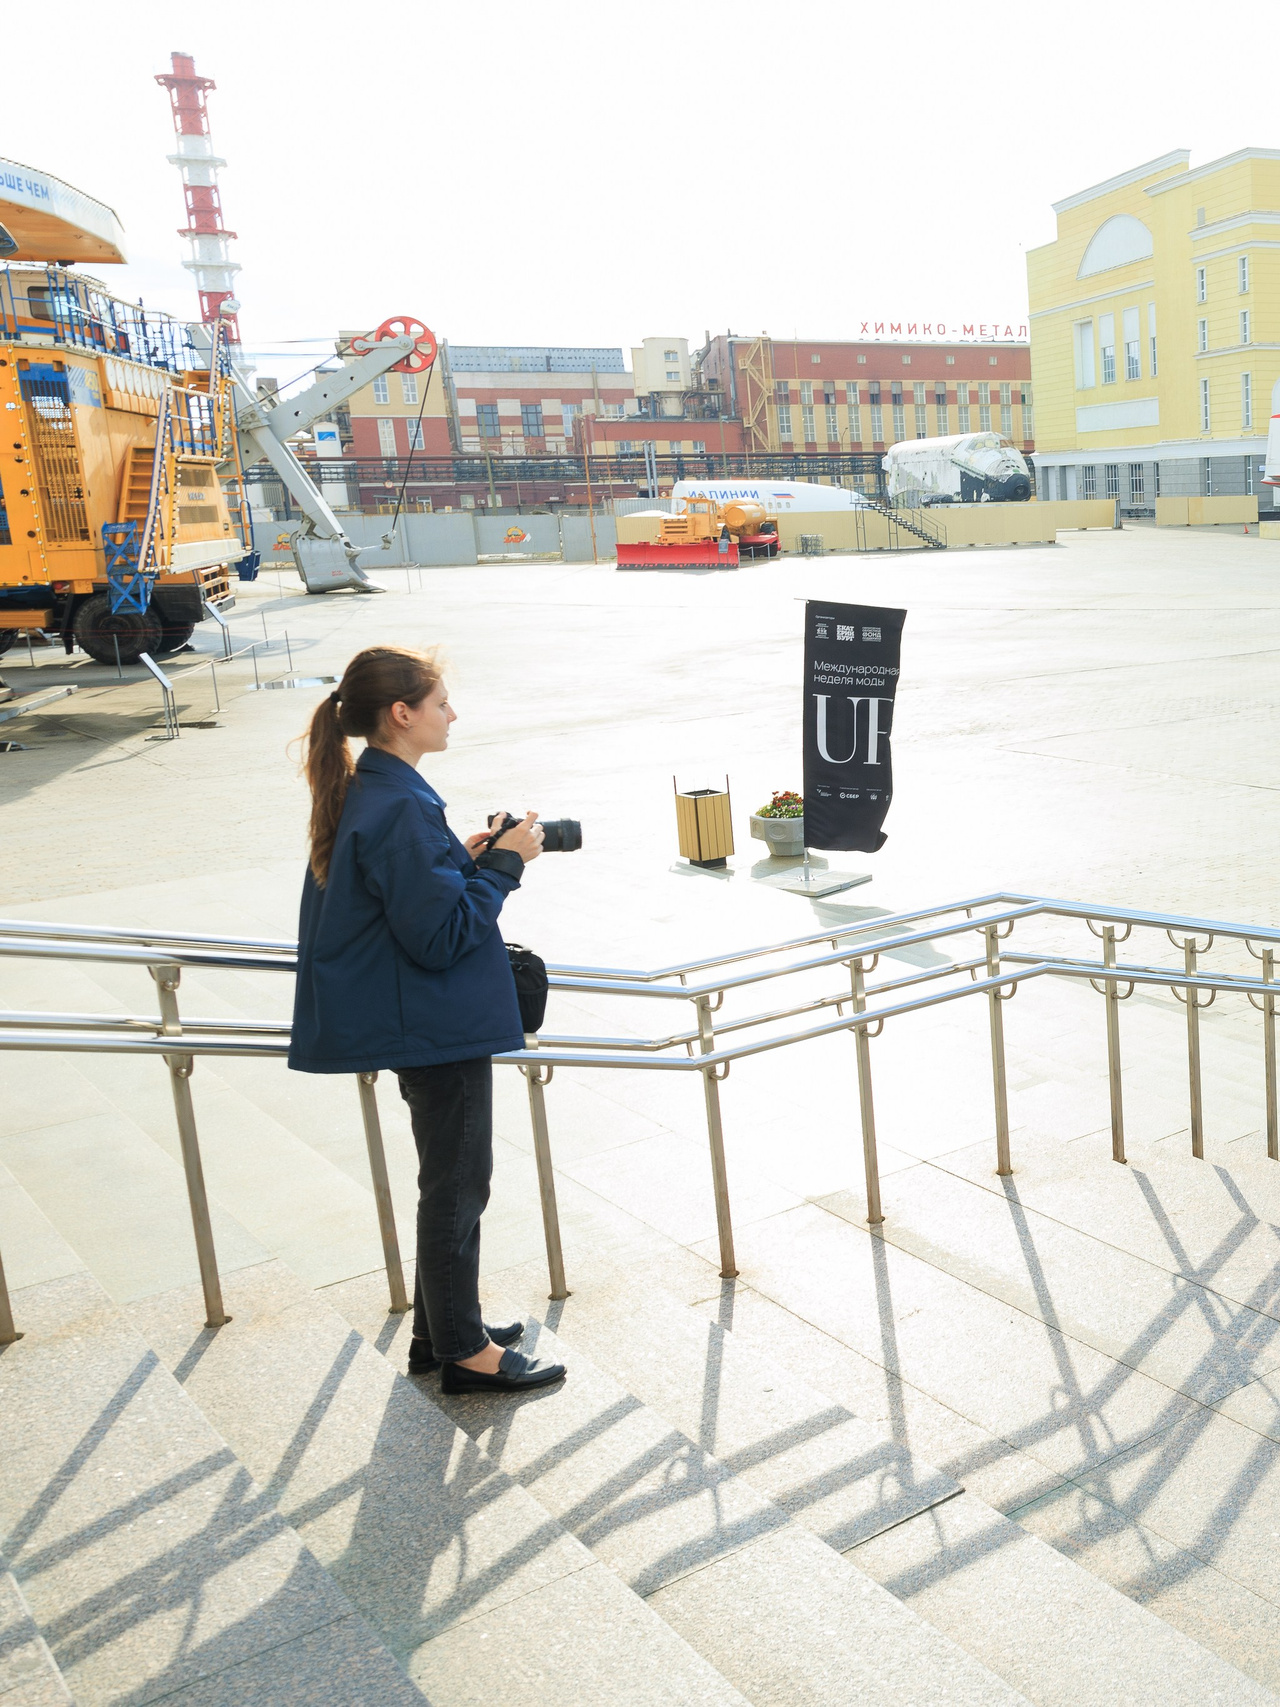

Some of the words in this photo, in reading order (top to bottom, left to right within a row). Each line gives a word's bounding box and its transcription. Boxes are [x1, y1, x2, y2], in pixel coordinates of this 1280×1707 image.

[25, 179, 50, 201] ЧЕМ
[813, 674, 854, 685] неделя
[855, 676, 886, 687] моды
